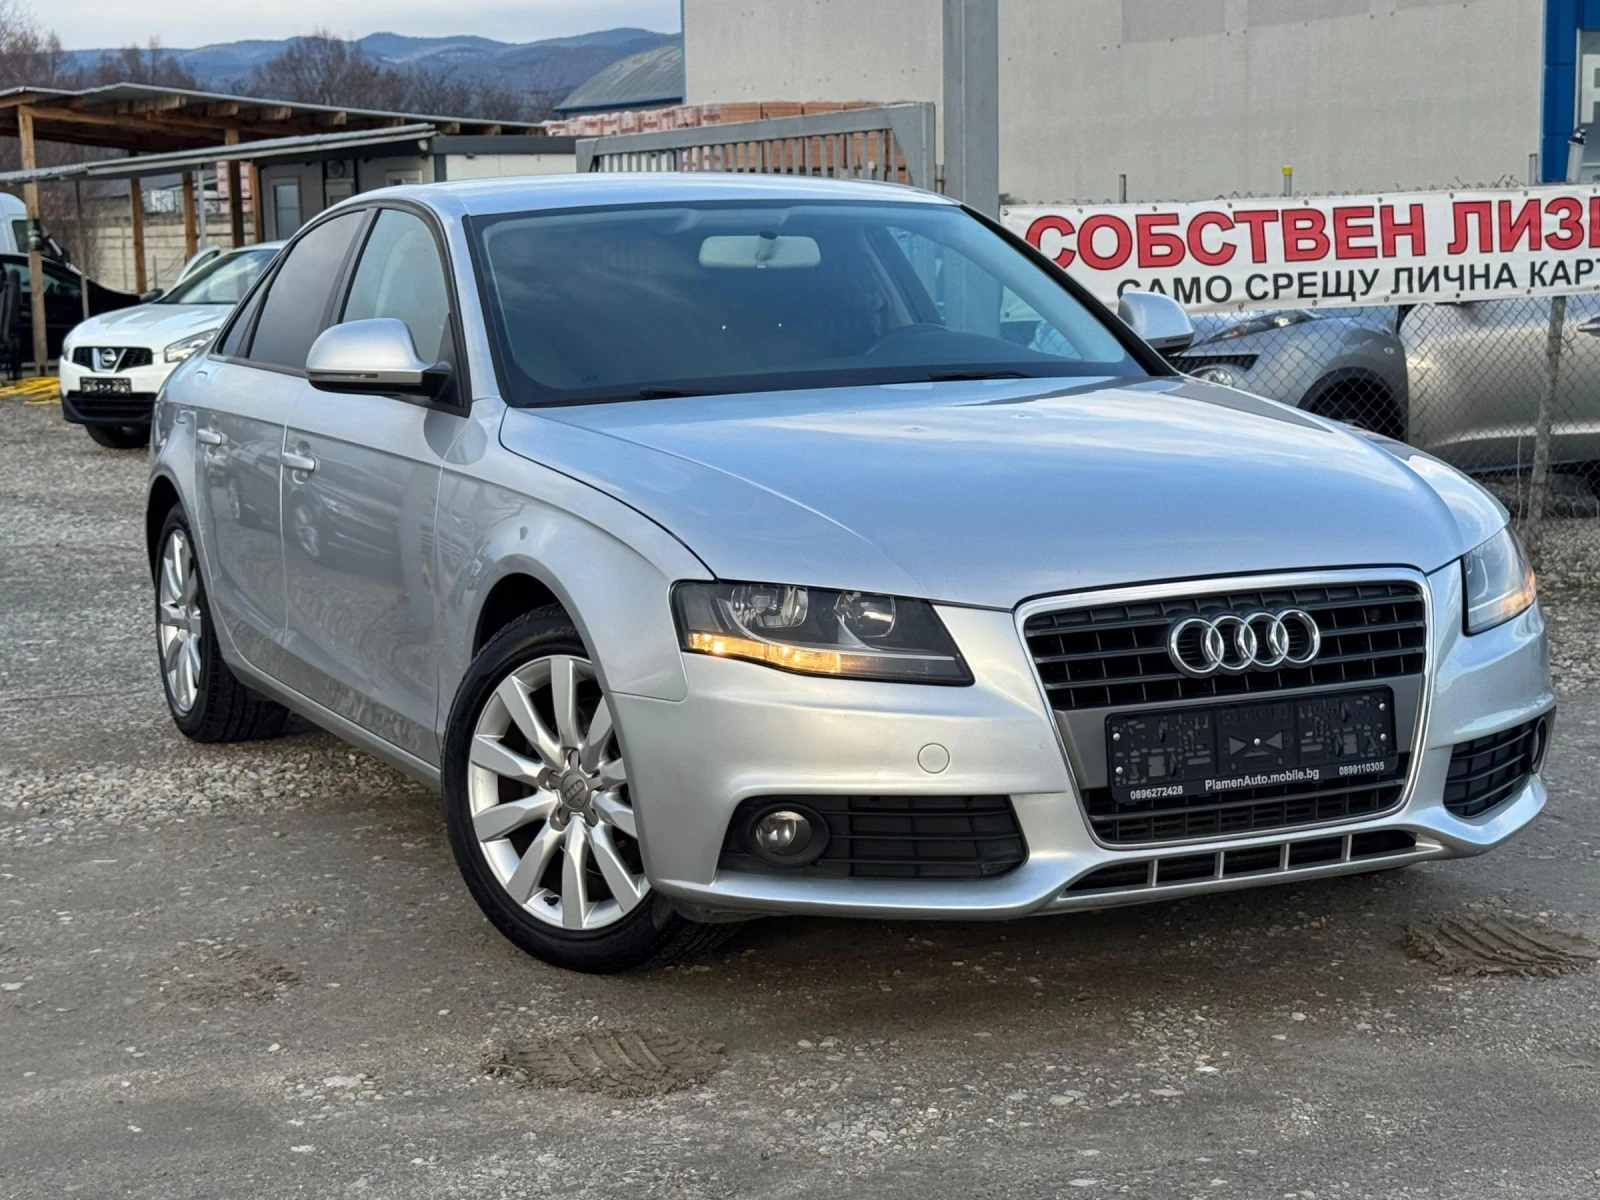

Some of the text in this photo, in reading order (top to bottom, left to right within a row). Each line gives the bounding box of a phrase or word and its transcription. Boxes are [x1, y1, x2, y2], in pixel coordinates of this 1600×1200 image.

[1025, 196, 1600, 271] СОБСТВЕН ЛИЗ
[1245, 268, 1380, 302] СРЕЩУ
[1391, 262, 1518, 295] ЛИЧНА
[1130, 761, 1385, 800] 0896272428 PlamenAuto.mobile.bg 0899110305
